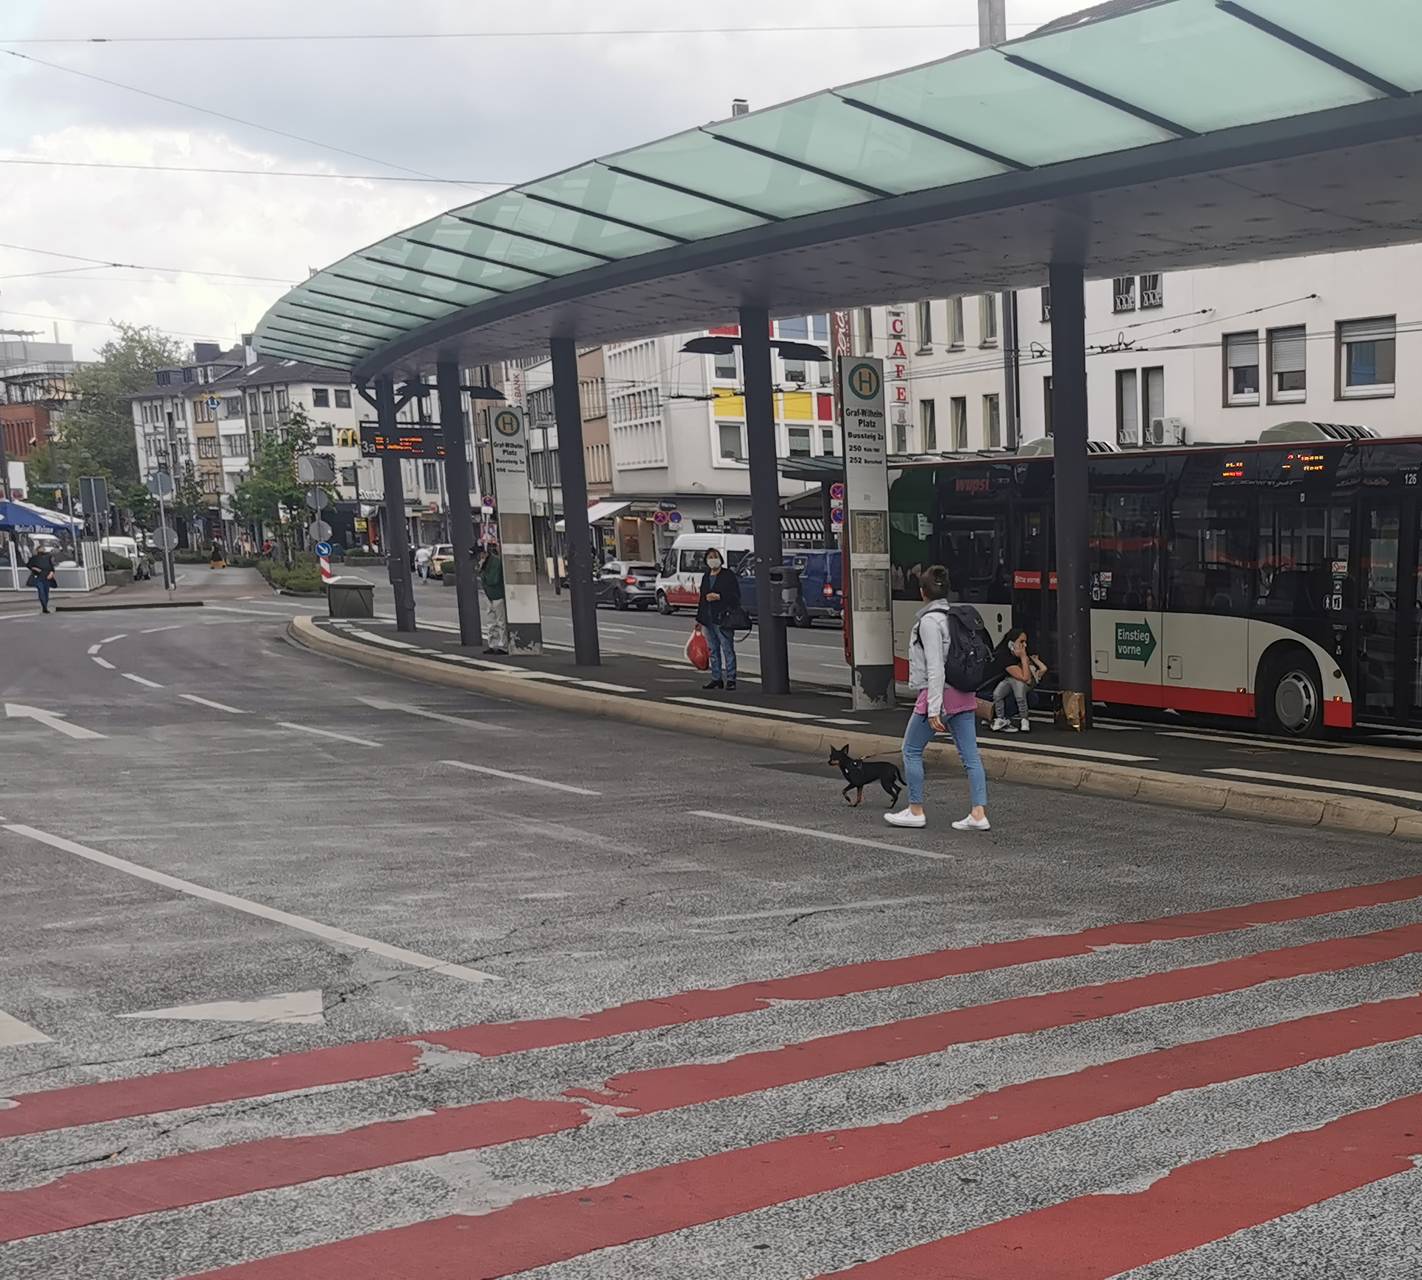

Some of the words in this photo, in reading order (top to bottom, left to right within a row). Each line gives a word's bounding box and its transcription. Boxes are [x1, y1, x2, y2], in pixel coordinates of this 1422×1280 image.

[858, 419, 876, 428] Platz
[361, 440, 376, 453] 3a
[849, 456, 862, 464] 252
[1404, 474, 1417, 485] 126
[1117, 628, 1150, 644] Einstieg
[1117, 645, 1142, 655] vorne
